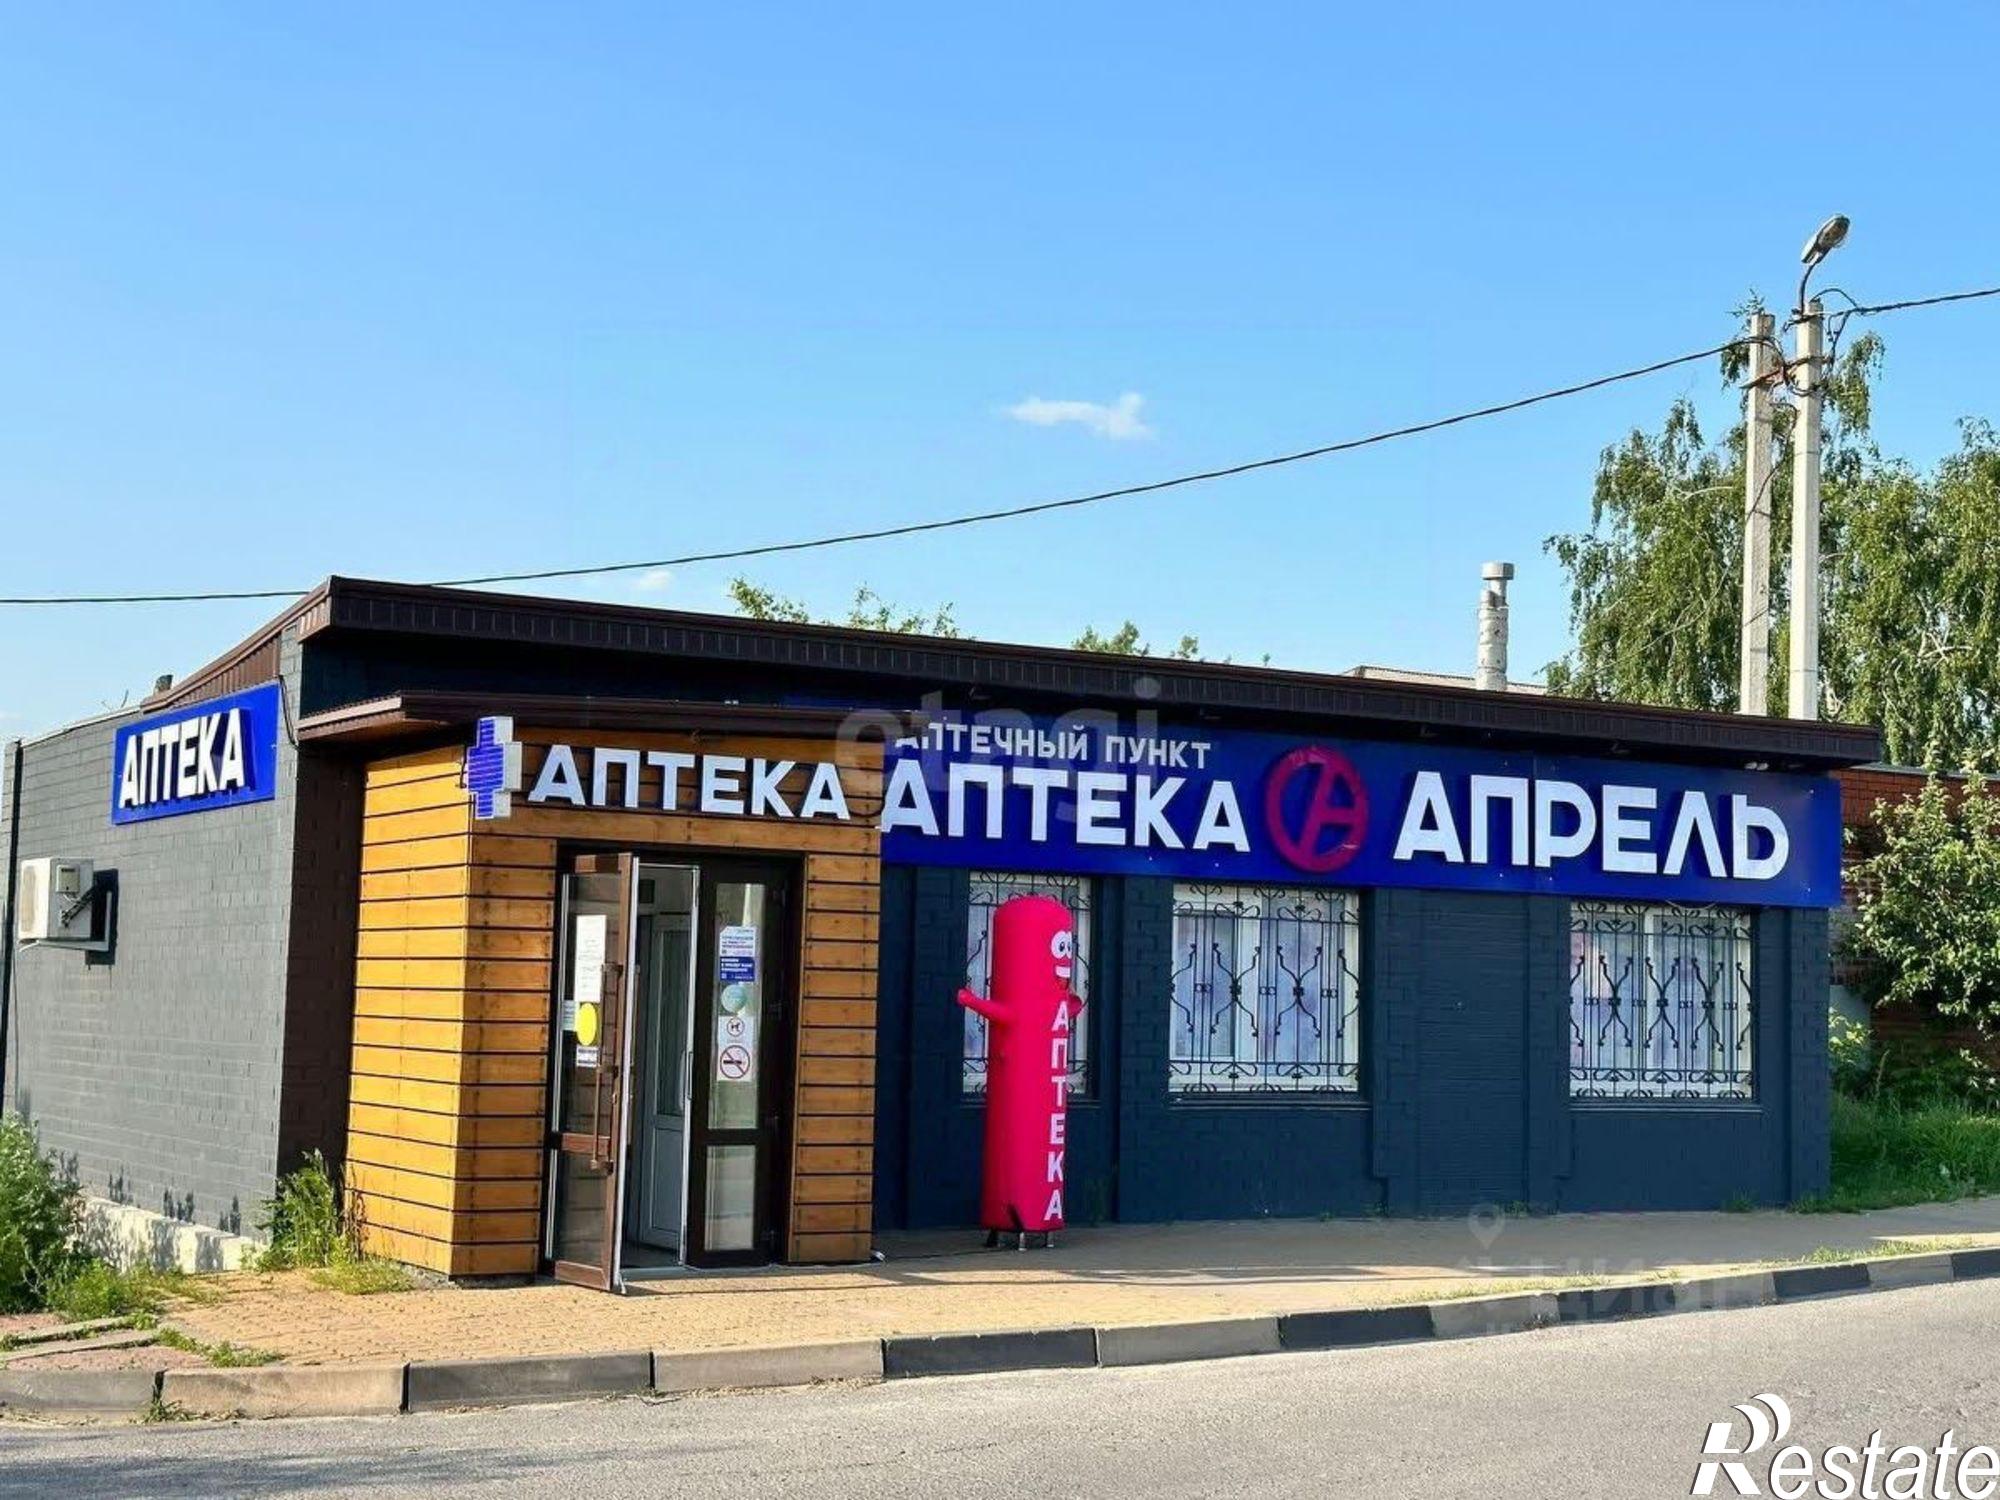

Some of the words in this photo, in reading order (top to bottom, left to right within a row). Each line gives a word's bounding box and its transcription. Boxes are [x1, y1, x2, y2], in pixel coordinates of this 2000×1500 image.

[118, 708, 245, 808] АПТЕКА
[527, 744, 850, 820] АПТЕКА
[1106, 736, 1211, 769] ПУНКТ
[880, 758, 1251, 853] АПТЕКА
[1393, 771, 1790, 880] АПРЕЛЬ
[1044, 1000, 1070, 1221] АПТЕКА
